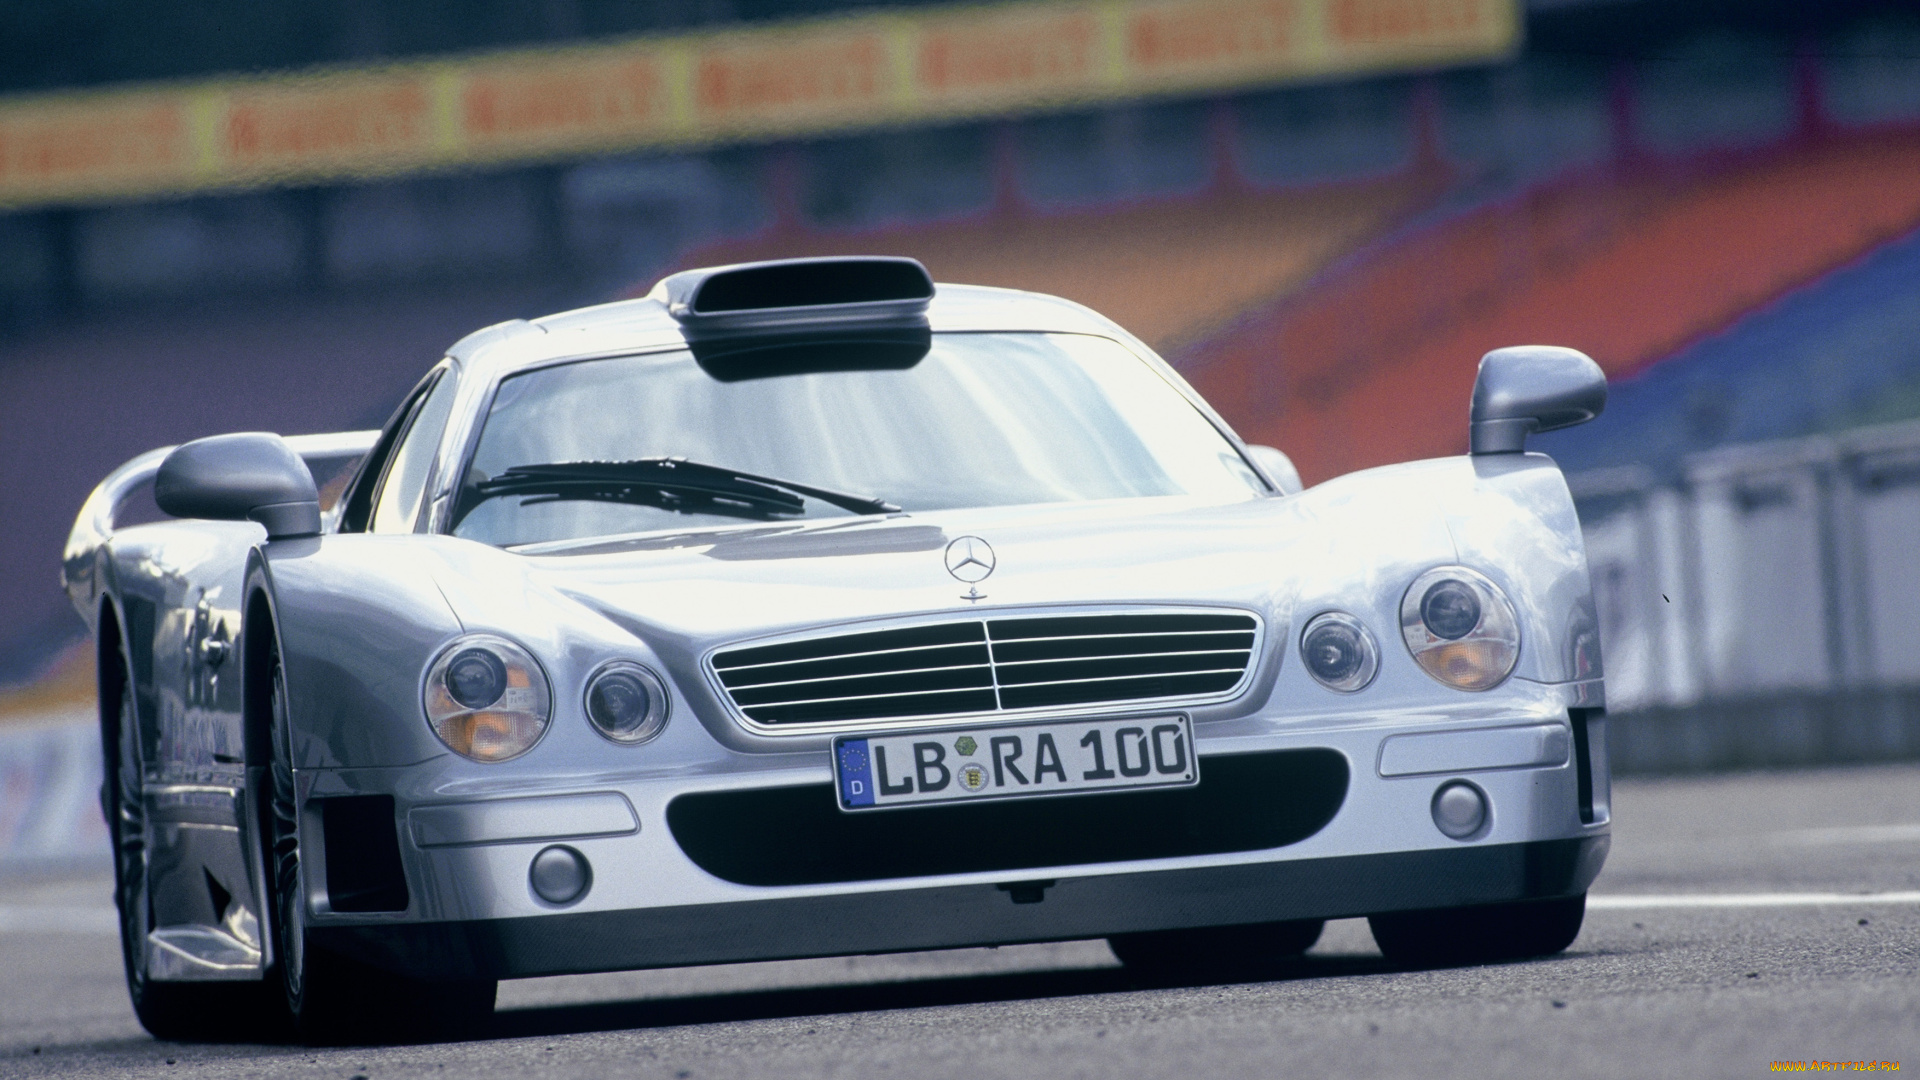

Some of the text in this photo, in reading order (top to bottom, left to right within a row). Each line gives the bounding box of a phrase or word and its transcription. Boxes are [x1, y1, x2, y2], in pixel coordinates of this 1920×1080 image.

[874, 724, 1187, 796] LB RA 100
[851, 780, 864, 795] D
